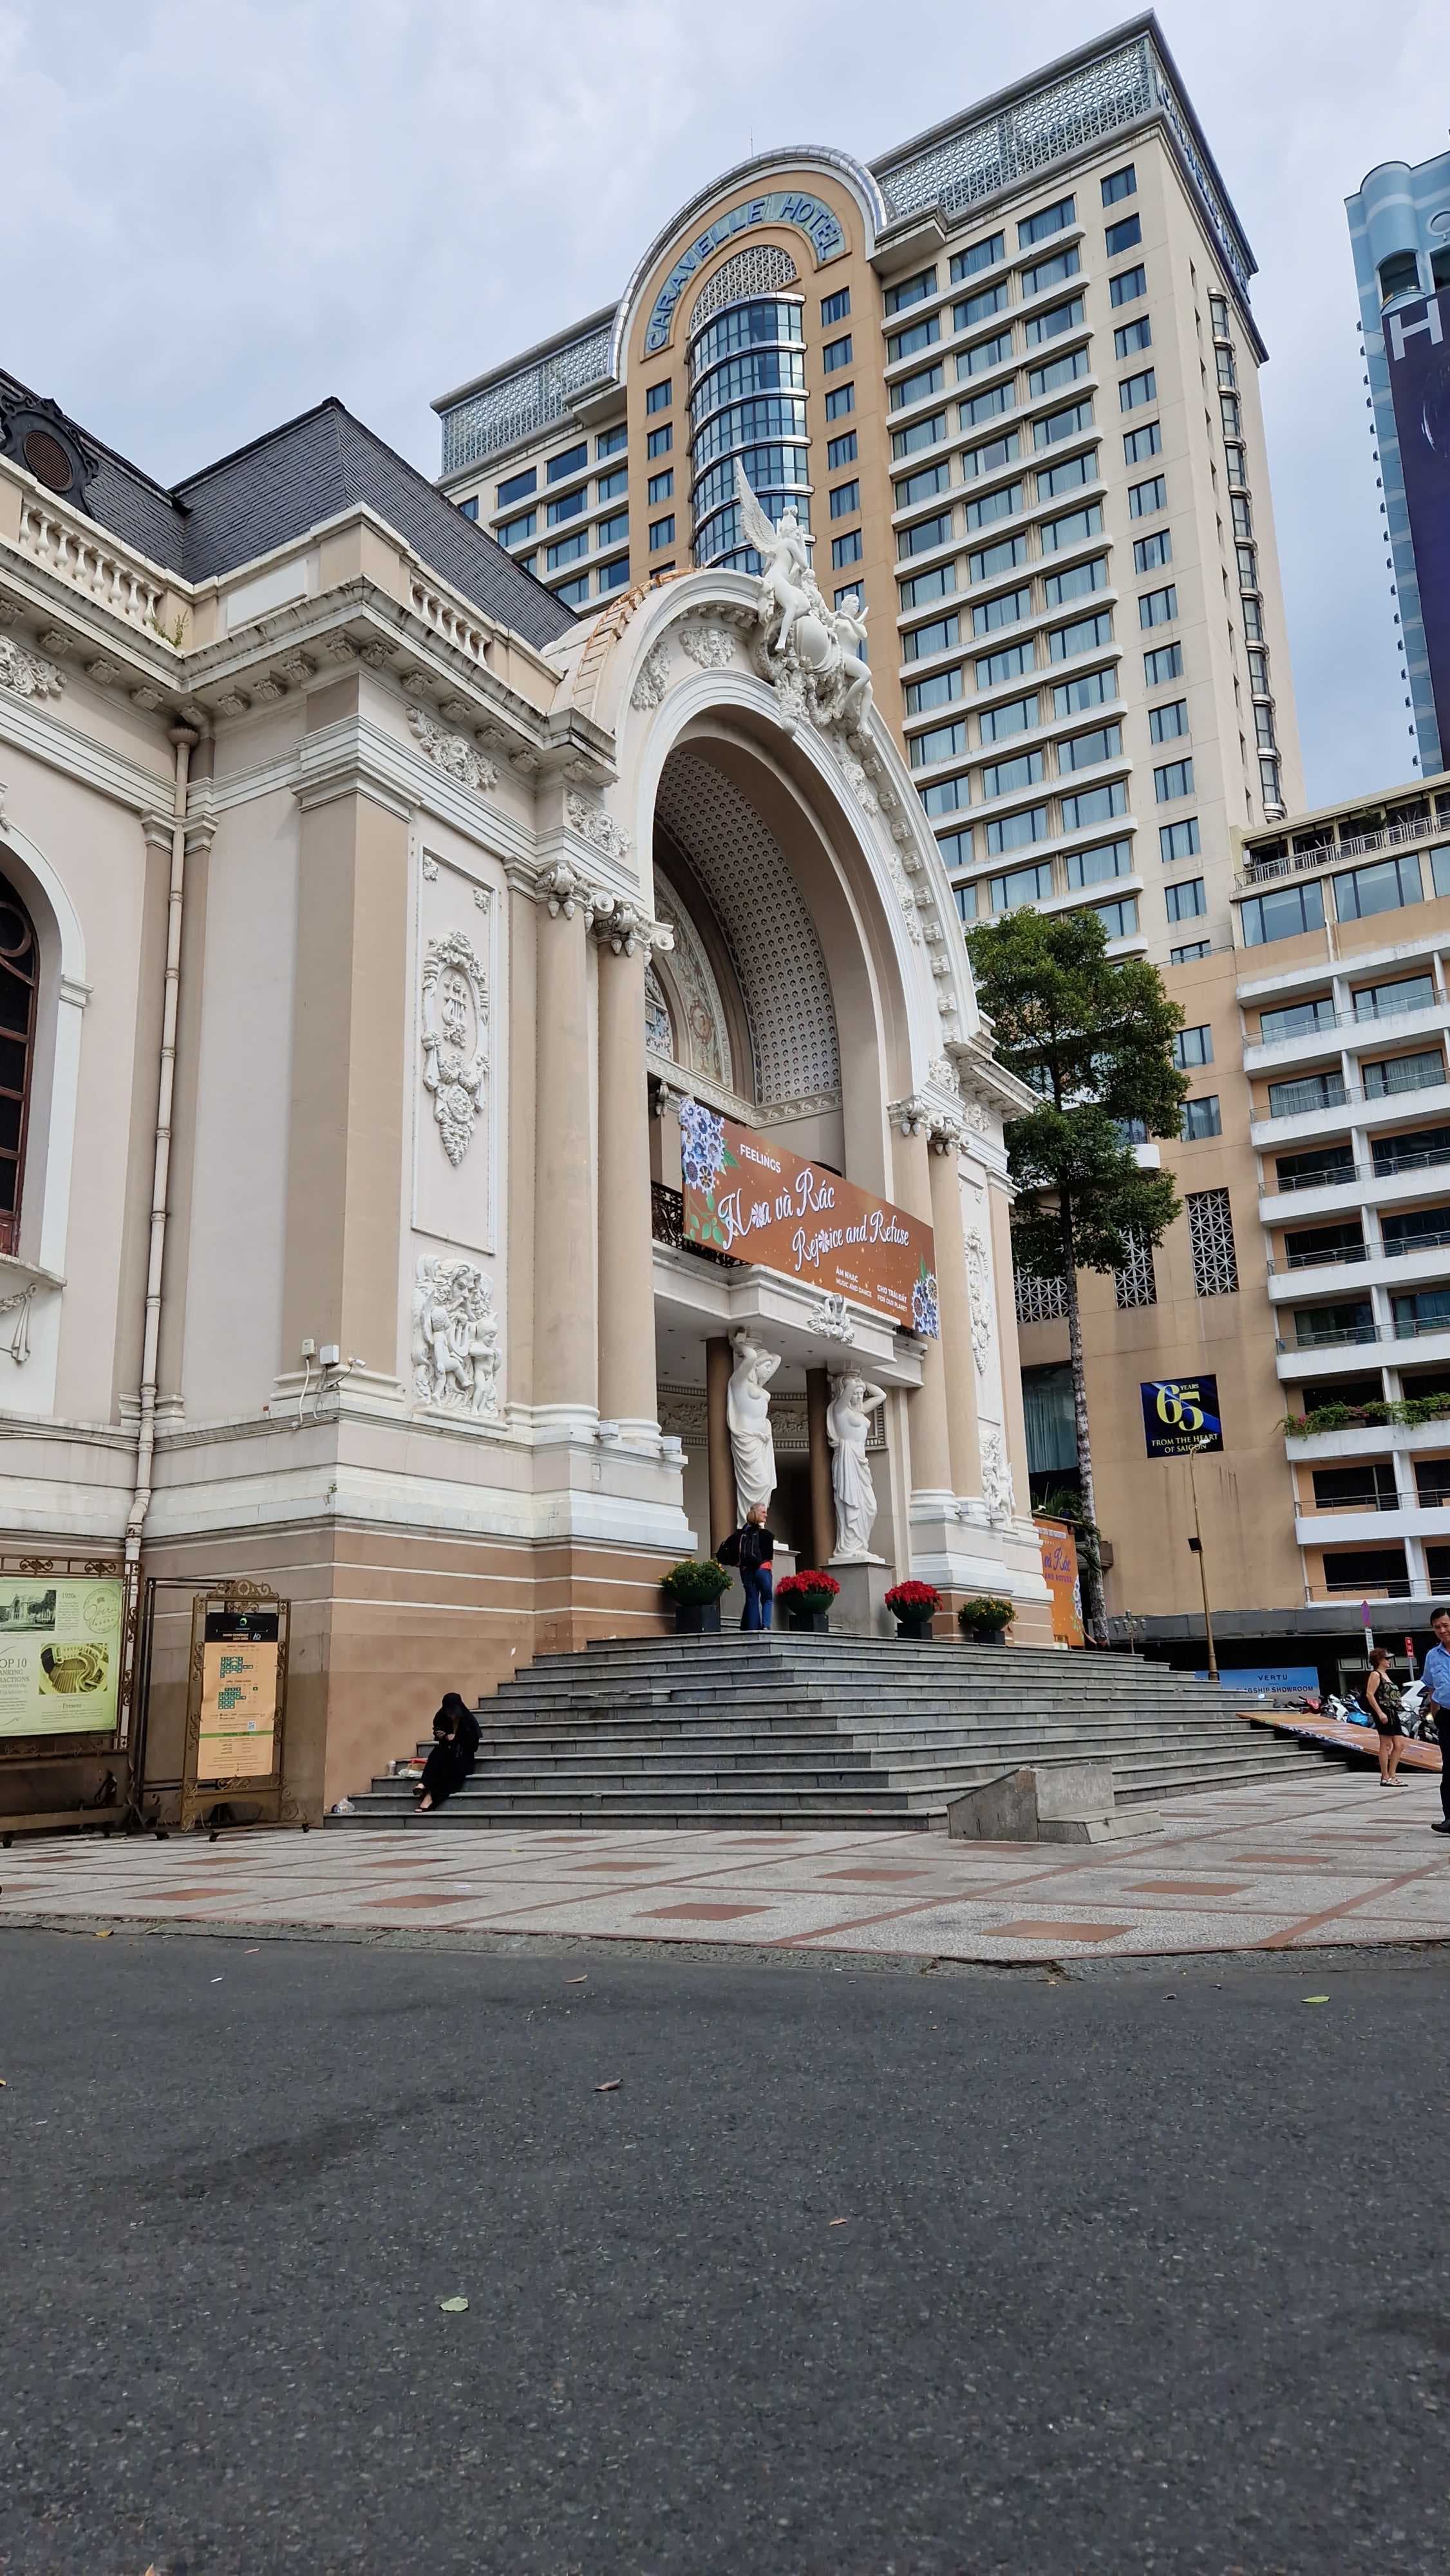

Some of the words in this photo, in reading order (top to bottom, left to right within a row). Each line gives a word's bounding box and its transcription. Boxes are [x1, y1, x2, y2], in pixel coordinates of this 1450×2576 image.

[648, 200, 766, 350] CARAVELLE
[780, 195, 840, 261] HOTEL
[740, 1143, 781, 1173] FEELINGS
[775, 1187, 793, 1220] và
[796, 1168, 835, 1217] Rác
[793, 1227, 844, 1272] Rejoice
[845, 1214, 868, 1244] and
[870, 1210, 909, 1247] Refuse
[849, 1283, 858, 1292] AND
[858, 1287, 872, 1298] DANCE
[877, 1285, 887, 1294] CHO
[894, 1301, 907, 1312] PLANET
[1156, 1385, 1204, 1431] 65
[1152, 1439, 1174, 1447] FROM
[1194, 1433, 1219, 1443] HEART
[1177, 1443, 1207, 1452] SAIGON
[0, 1658, 14, 1669] OP
[17, 1658, 27, 1668] 10
[1272, 1685, 1313, 1694] SHOWROOM
